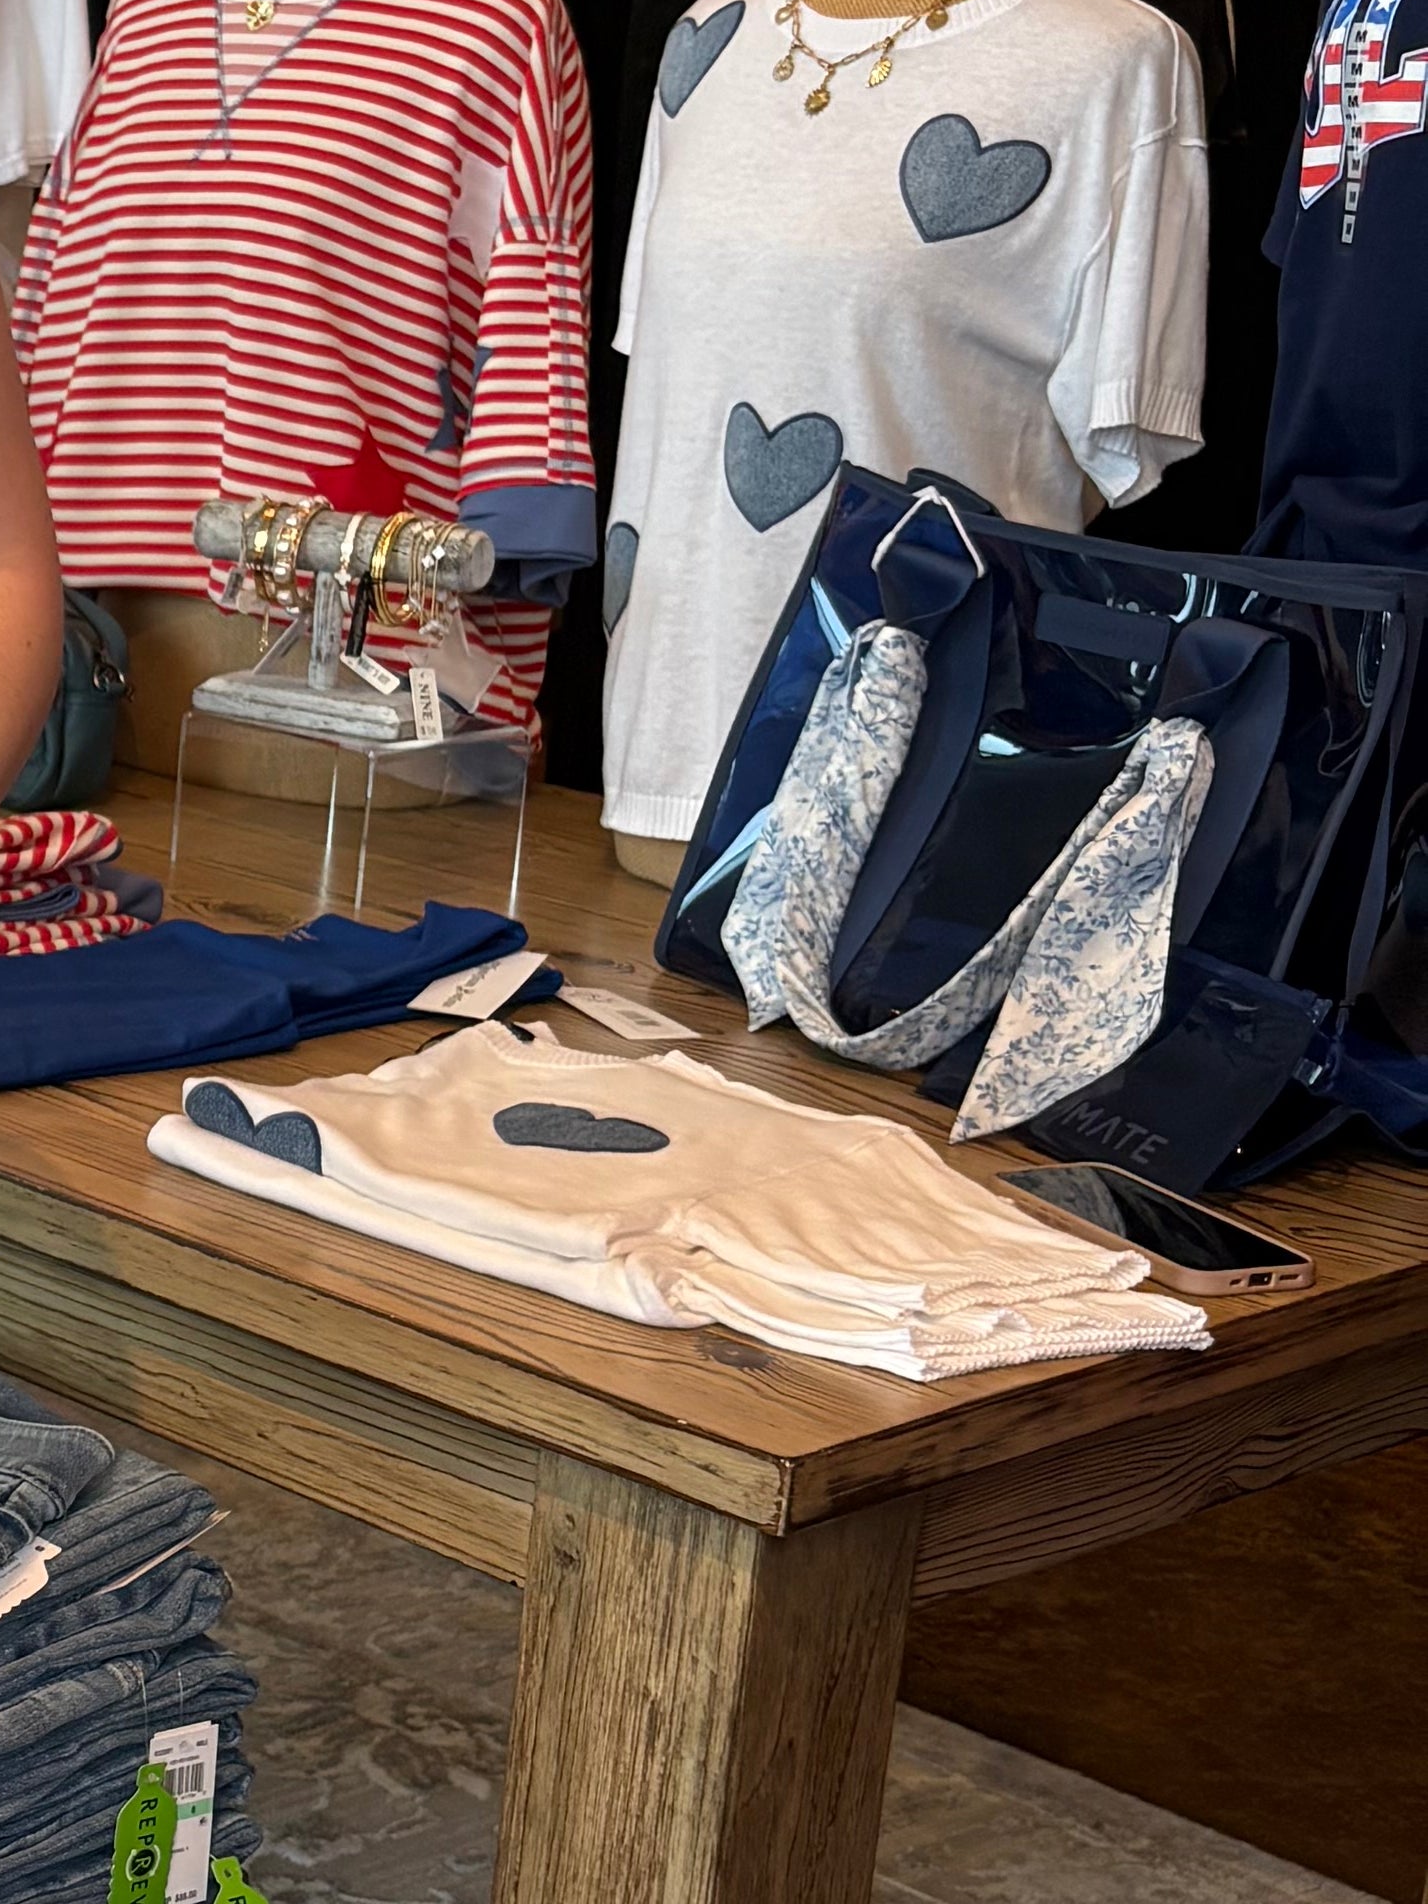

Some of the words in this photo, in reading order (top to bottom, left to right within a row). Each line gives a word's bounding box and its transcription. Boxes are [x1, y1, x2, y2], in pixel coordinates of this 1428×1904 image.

[1354, 30, 1368, 44] M
[1350, 62, 1363, 76] M
[1347, 94, 1359, 108] M
[1350, 125, 1362, 139] M
[418, 683, 434, 721] NINE
[1061, 1100, 1169, 1165] MATE
